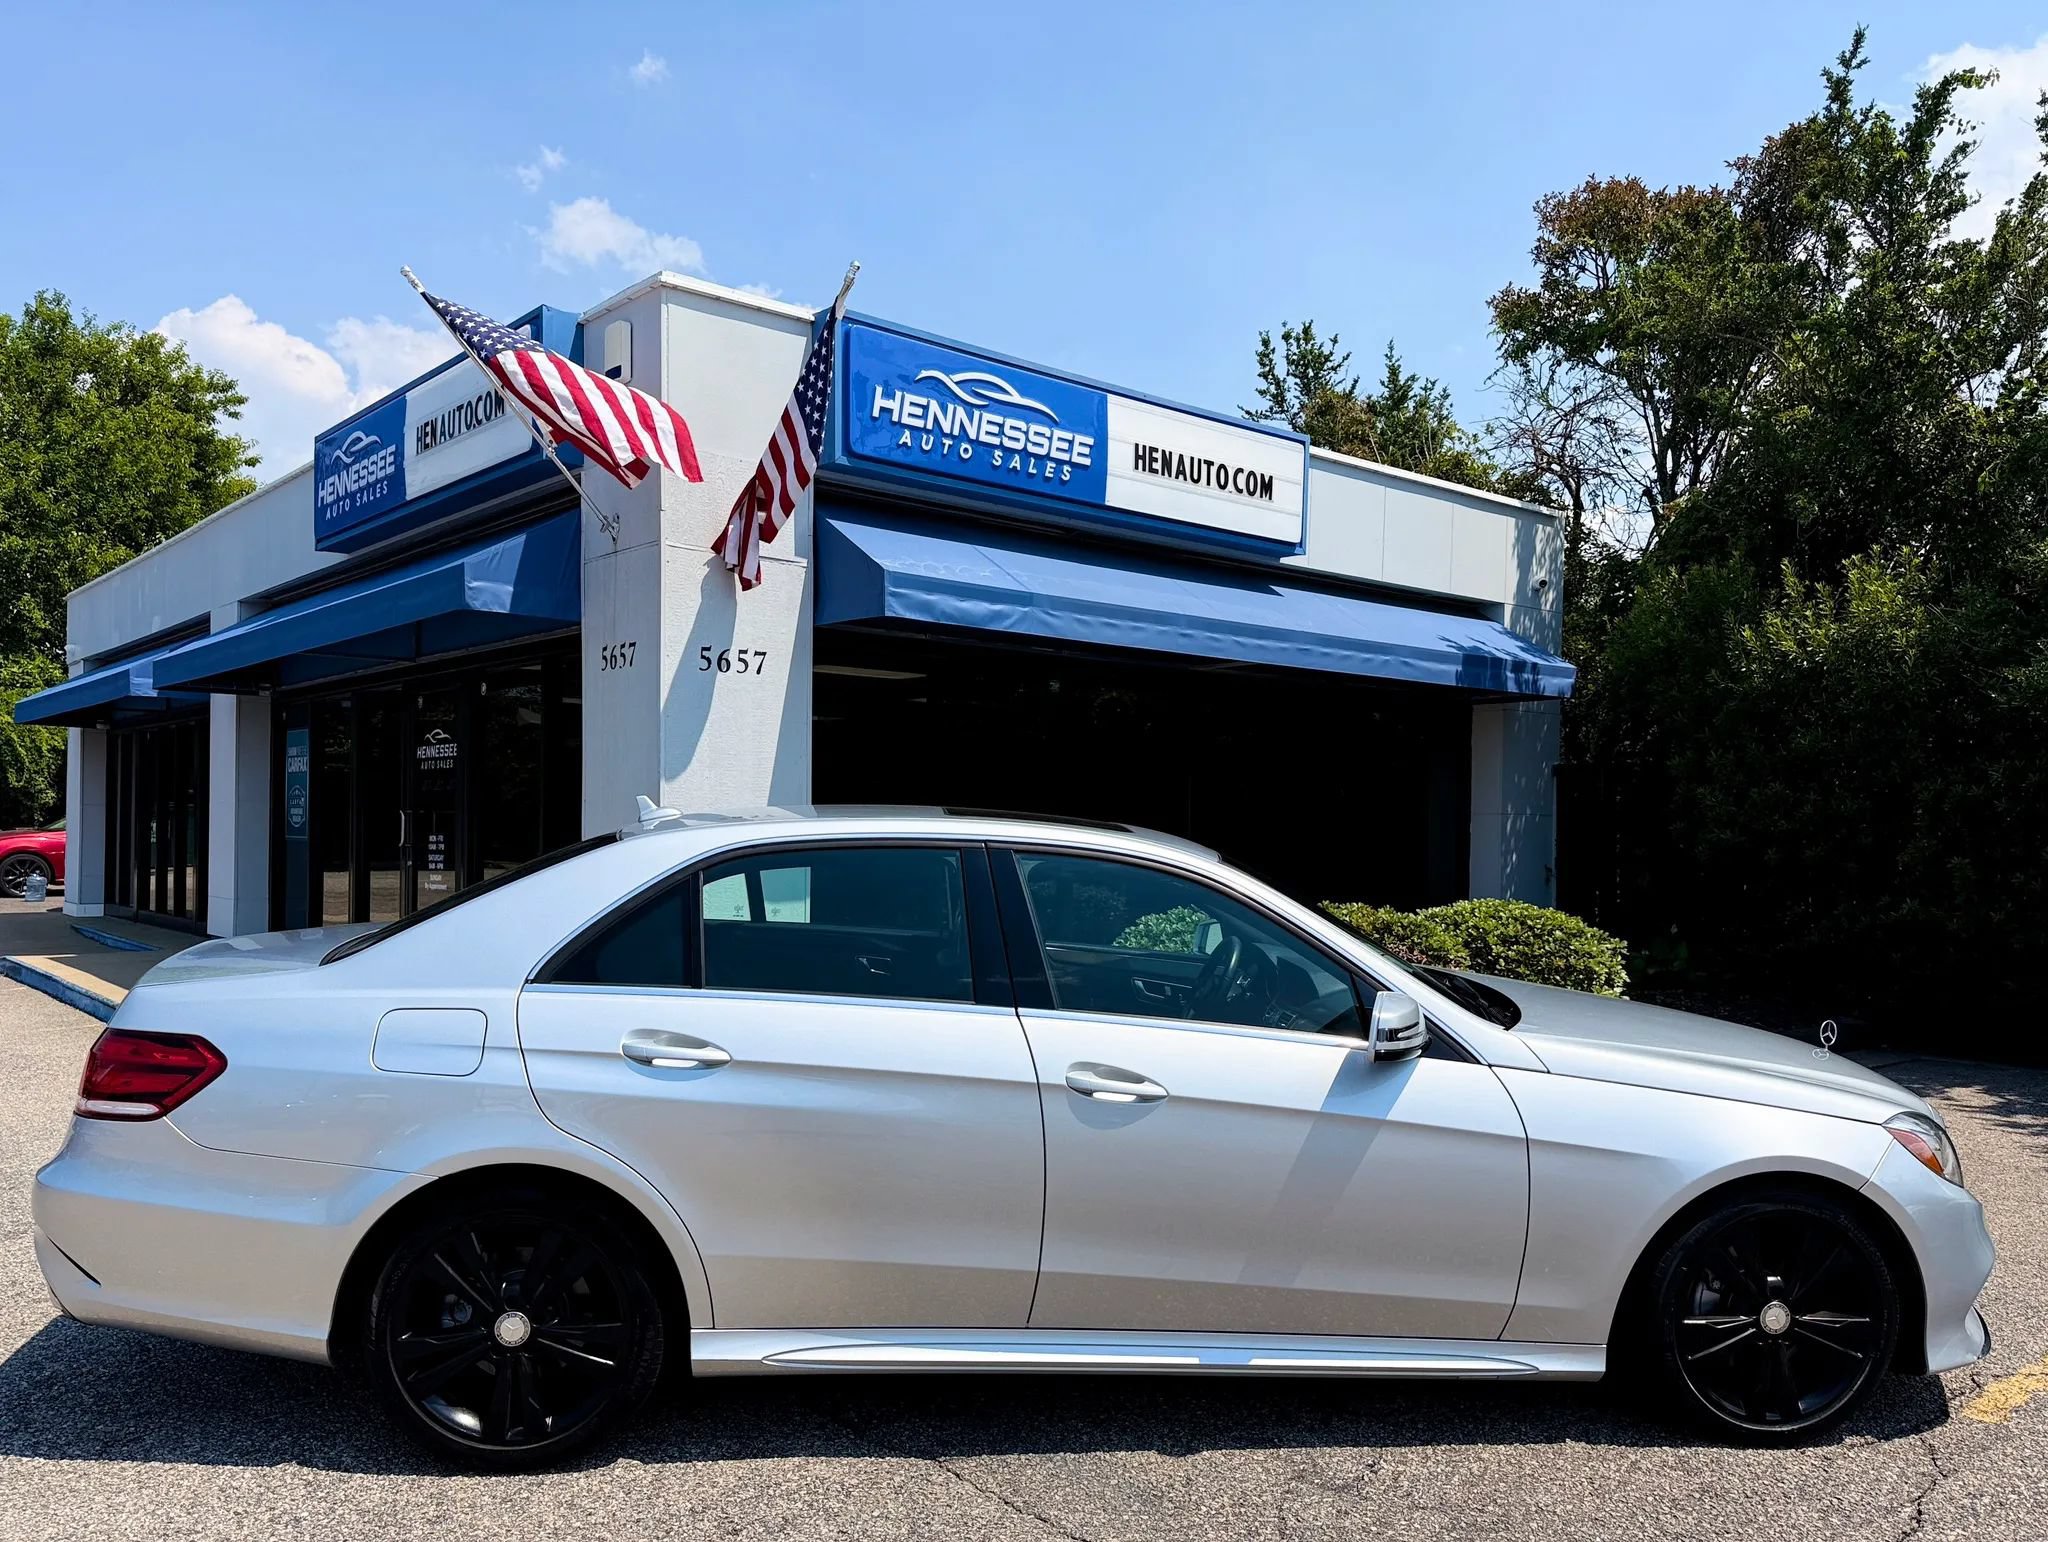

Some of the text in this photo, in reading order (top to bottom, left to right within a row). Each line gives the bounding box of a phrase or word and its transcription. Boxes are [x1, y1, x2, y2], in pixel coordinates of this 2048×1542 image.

[872, 384, 1094, 466] HENNESSEE
[899, 429, 1072, 482] AUTO SALES
[318, 444, 396, 508] HENNESSEE
[325, 480, 388, 521] AUTO SALES
[601, 641, 637, 671] 5657
[698, 645, 768, 675] 5657
[416, 743, 457, 759] HENNESSEE
[421, 759, 454, 770] AUTO SALES
